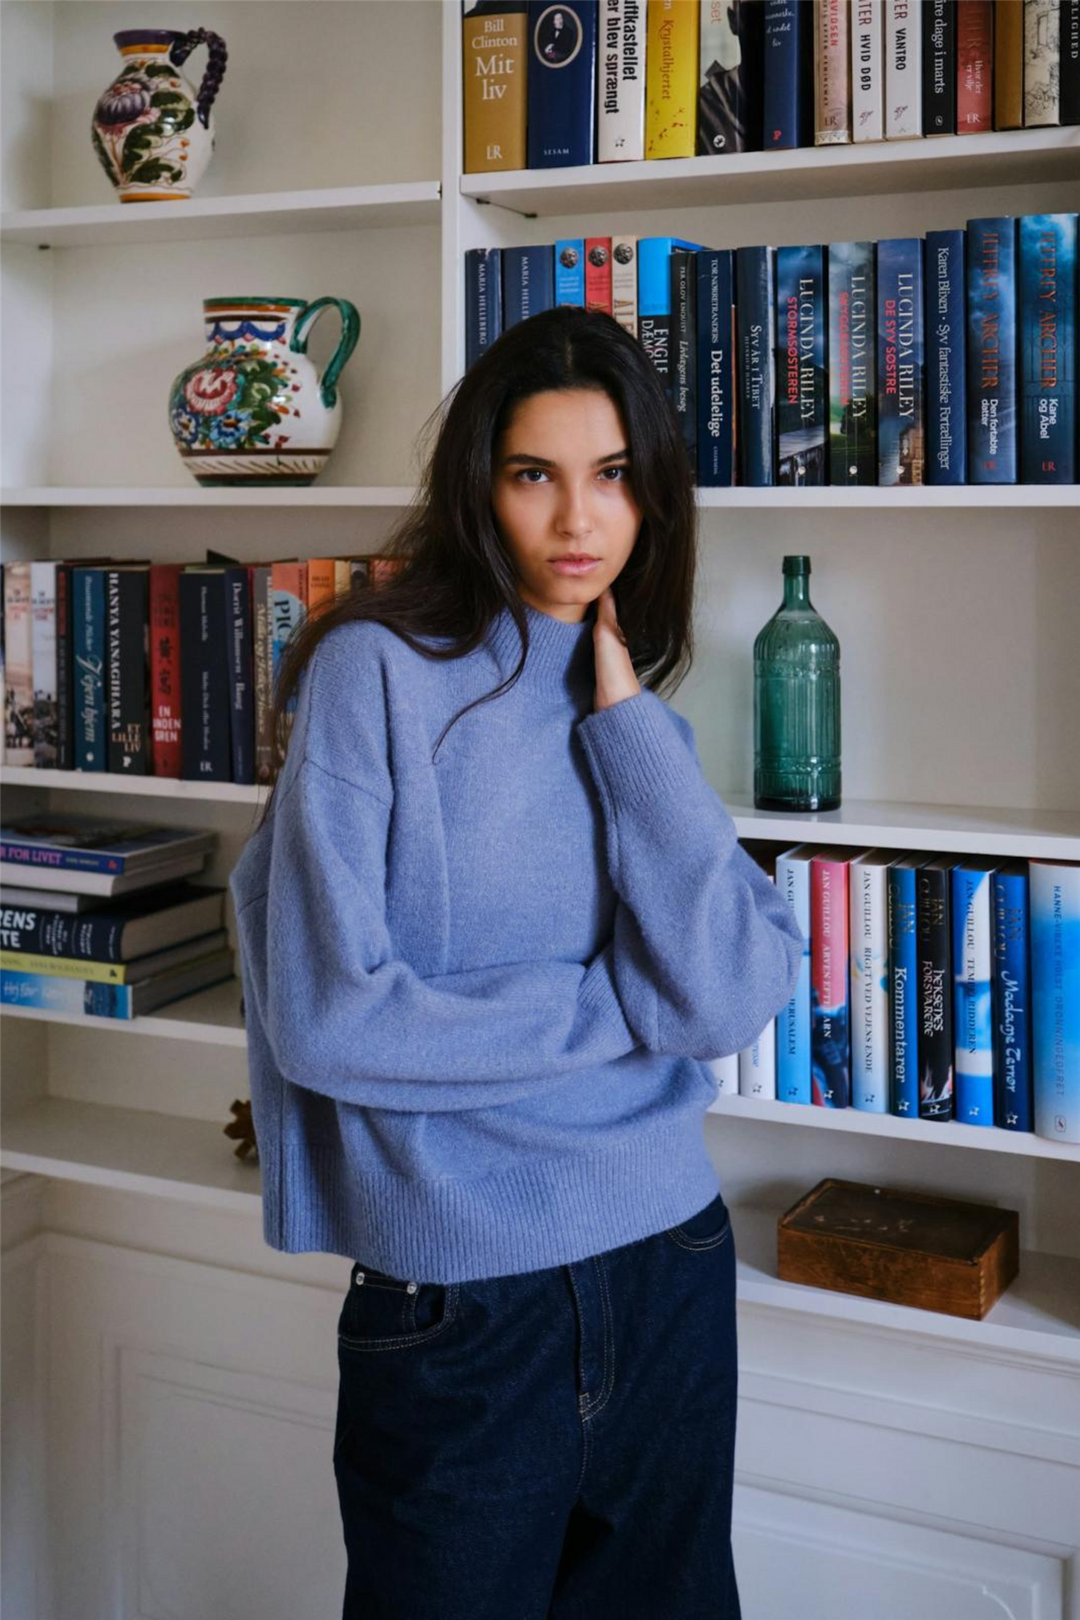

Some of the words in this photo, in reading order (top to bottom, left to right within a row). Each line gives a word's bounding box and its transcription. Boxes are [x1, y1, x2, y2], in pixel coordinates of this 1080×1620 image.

[483, 18, 505, 33] Bill
[858, 0, 872, 26] TER
[472, 36, 518, 49] Clinton
[607, 18, 622, 49] blev
[861, 34, 871, 62] HVID
[931, 19, 948, 48] dage
[475, 53, 515, 76] Mit
[658, 20, 674, 101] Krystalhjertet
[895, 28, 907, 71] VANTRO
[604, 54, 620, 114] sprængt
[860, 67, 871, 91] DØD
[934, 58, 946, 93] marts
[964, 74, 974, 91] vilje
[966, 65, 973, 73] er
[975, 60, 984, 80] Hvor
[482, 79, 508, 100] liv
[975, 81, 984, 94] der
[486, 145, 503, 160] LR
[543, 147, 570, 156] SESAM
[478, 263, 487, 293] MARIA
[521, 256, 529, 286] MARIA
[711, 258, 719, 274] TOR
[938, 247, 950, 278] Karen
[983, 232, 999, 300] JEFFREY
[1040, 231, 1056, 302] JEFFREY
[711, 275, 719, 343] NØRRETRANDERS
[885, 299, 896, 316] DE
[938, 280, 950, 313] Blixen
[478, 295, 487, 345] HELLEBERG
[799, 278, 815, 361] LUCINDA
[851, 276, 866, 358] LUCINDA
[898, 273, 914, 358] LUCINDA
[885, 320, 896, 343] SYV
[936, 324, 950, 344] Syv
[677, 340, 689, 385] Livlægens
[711, 349, 723, 374] Det
[751, 349, 761, 364] ÅR
[787, 296, 799, 404] STORMSØSTEREN
[982, 313, 999, 388] ARCHER
[1040, 311, 1056, 389] ARCHER
[885, 346, 897, 395] SØSTRE
[939, 347, 952, 403] fantastiske
[677, 387, 689, 413] besøg
[708, 377, 723, 437] udelelige
[799, 367, 815, 421] RILEY
[852, 366, 867, 421] RILEY
[899, 364, 914, 420] RILEY
[1038, 398, 1048, 413] og
[981, 398, 990, 426] datter
[989, 399, 998, 418] Den
[1049, 398, 1058, 425] Kane
[937, 407, 952, 470] Fortællinger
[989, 418, 999, 454] fortabte
[1040, 414, 1049, 439] Abel
[109, 573, 119, 626] HANYA
[232, 582, 242, 615] Dorrit
[110, 628, 121, 729] YANAGIHARA
[159, 705, 171, 717] EN
[8, 847, 30, 860] FOR
[31, 849, 63, 866] LIVET
[822, 870, 831, 889] JAN
[864, 871, 872, 890] JAN
[966, 880, 974, 899] JAN
[0, 909, 37, 931] ENS
[822, 891, 831, 938] GUILLOU
[864, 893, 872, 939] GUILLOU
[966, 901, 975, 950] GUILLOU
[1053, 885, 1063, 957] HANNE-VIBEKE
[822, 944, 831, 979] ARVEN
[864, 947, 872, 979] RIGET
[1053, 960, 1063, 990] HOLST
[864, 981, 872, 1003] VED
[922, 960, 934, 1037] FORSVARERE
[999, 970, 1024, 1043] Madame
[823, 1017, 831, 1038] ARN
[864, 1005, 872, 1043] VEJENS
[894, 967, 908, 1083] Kommentarer
[865, 1045, 873, 1073] ENDE
[1005, 1047, 1022, 1093] Terror
